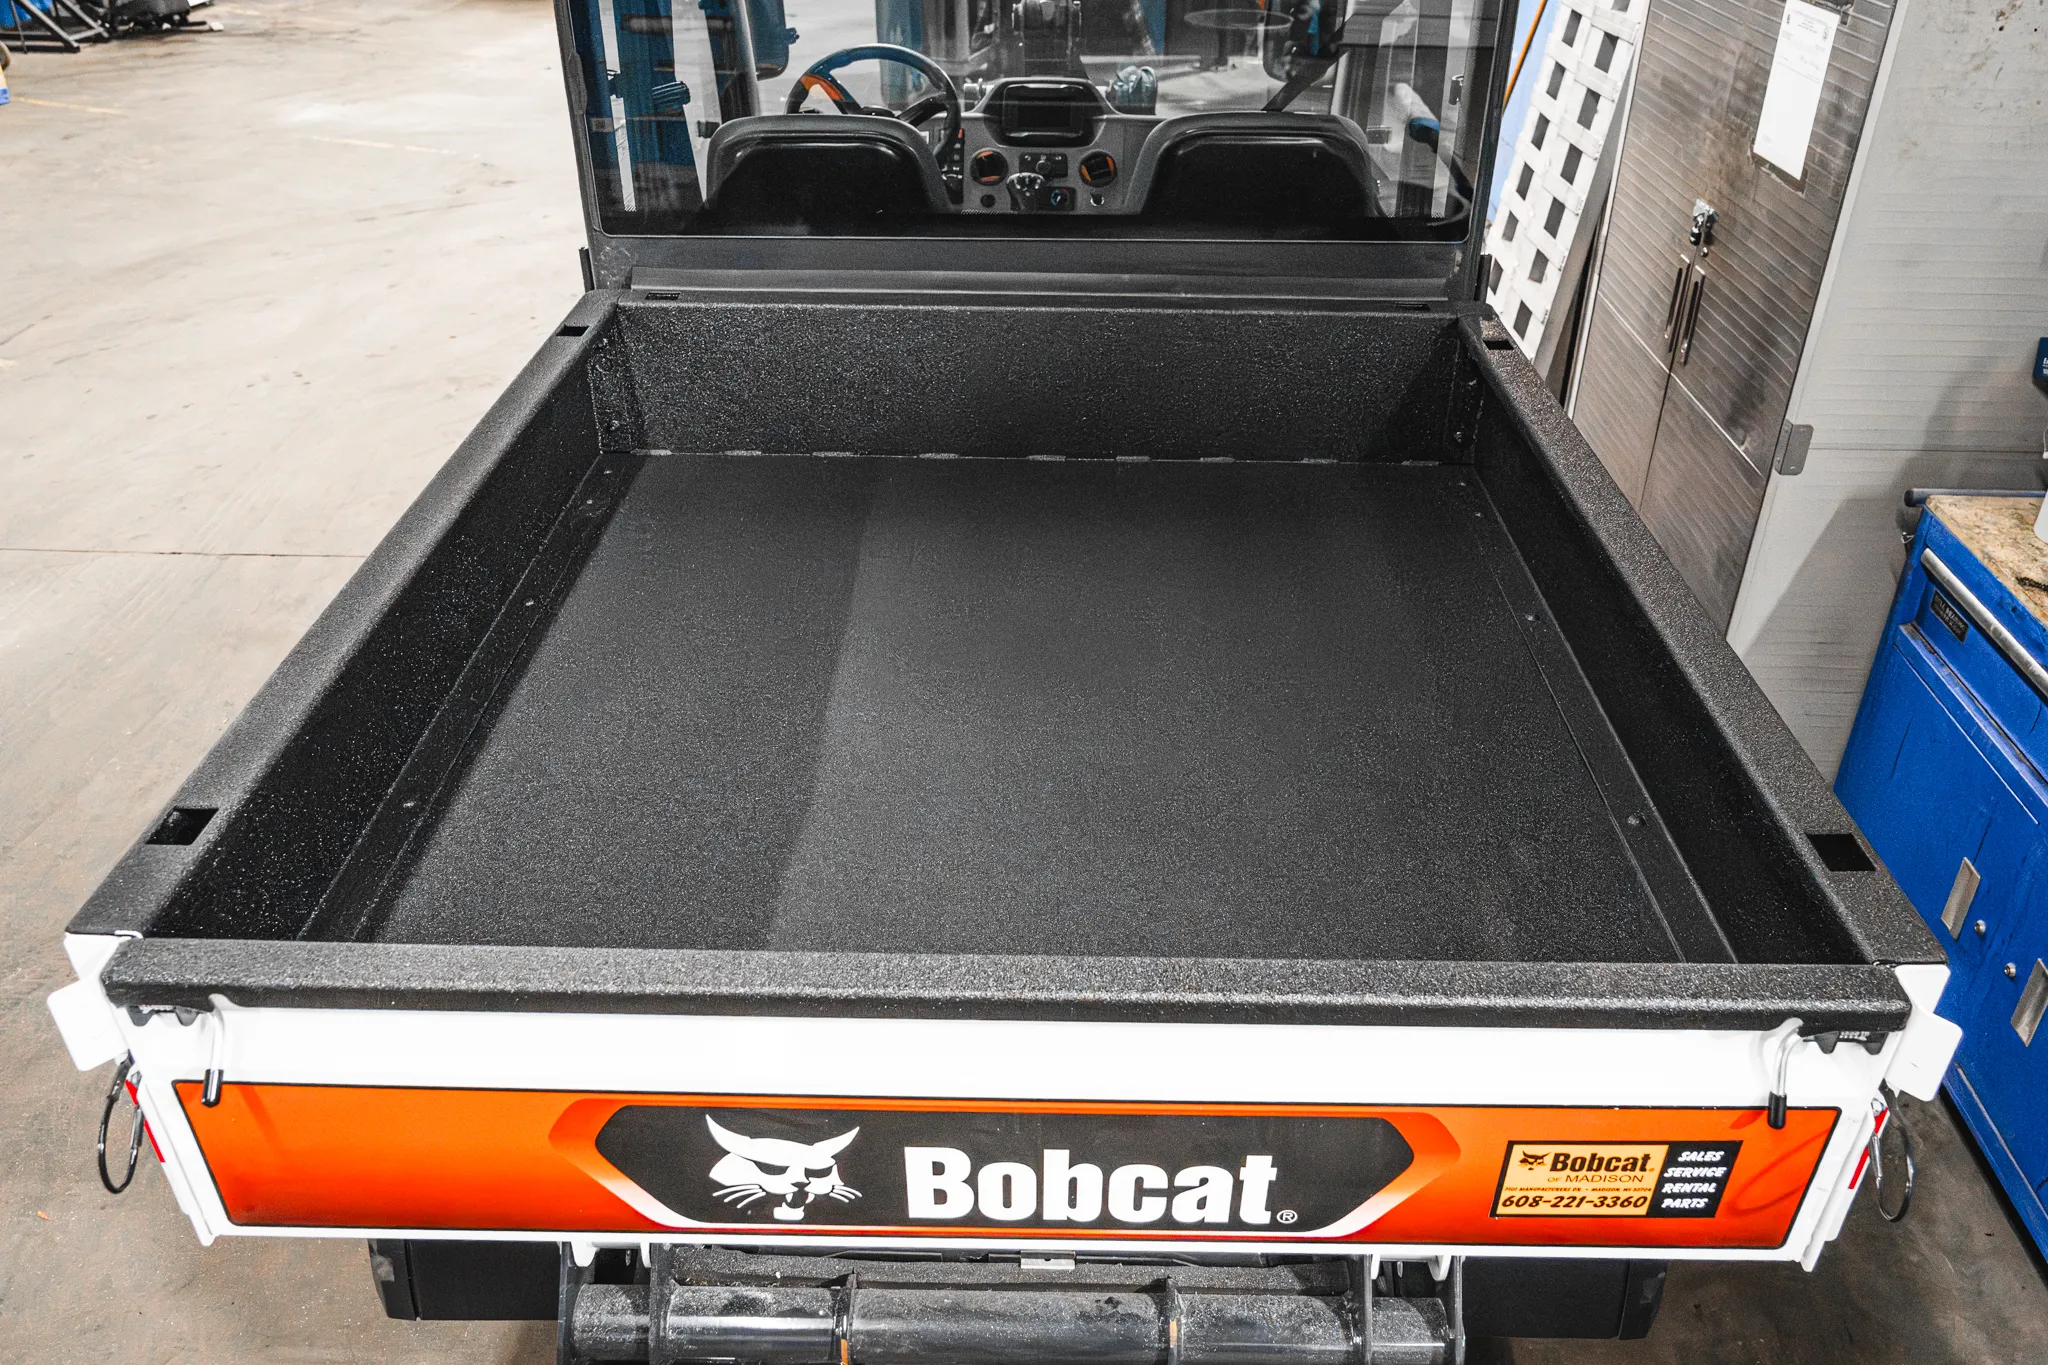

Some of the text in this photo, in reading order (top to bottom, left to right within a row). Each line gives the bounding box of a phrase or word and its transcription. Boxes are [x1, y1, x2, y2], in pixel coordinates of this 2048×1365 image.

[1678, 1151, 1725, 1162] SALES
[1663, 1167, 1727, 1178] SERVICE
[1565, 1175, 1644, 1183] MADISON
[1661, 1183, 1717, 1194] RENTAL
[1501, 1195, 1648, 1208] 608-221-3360
[1661, 1198, 1709, 1209] PARTS
